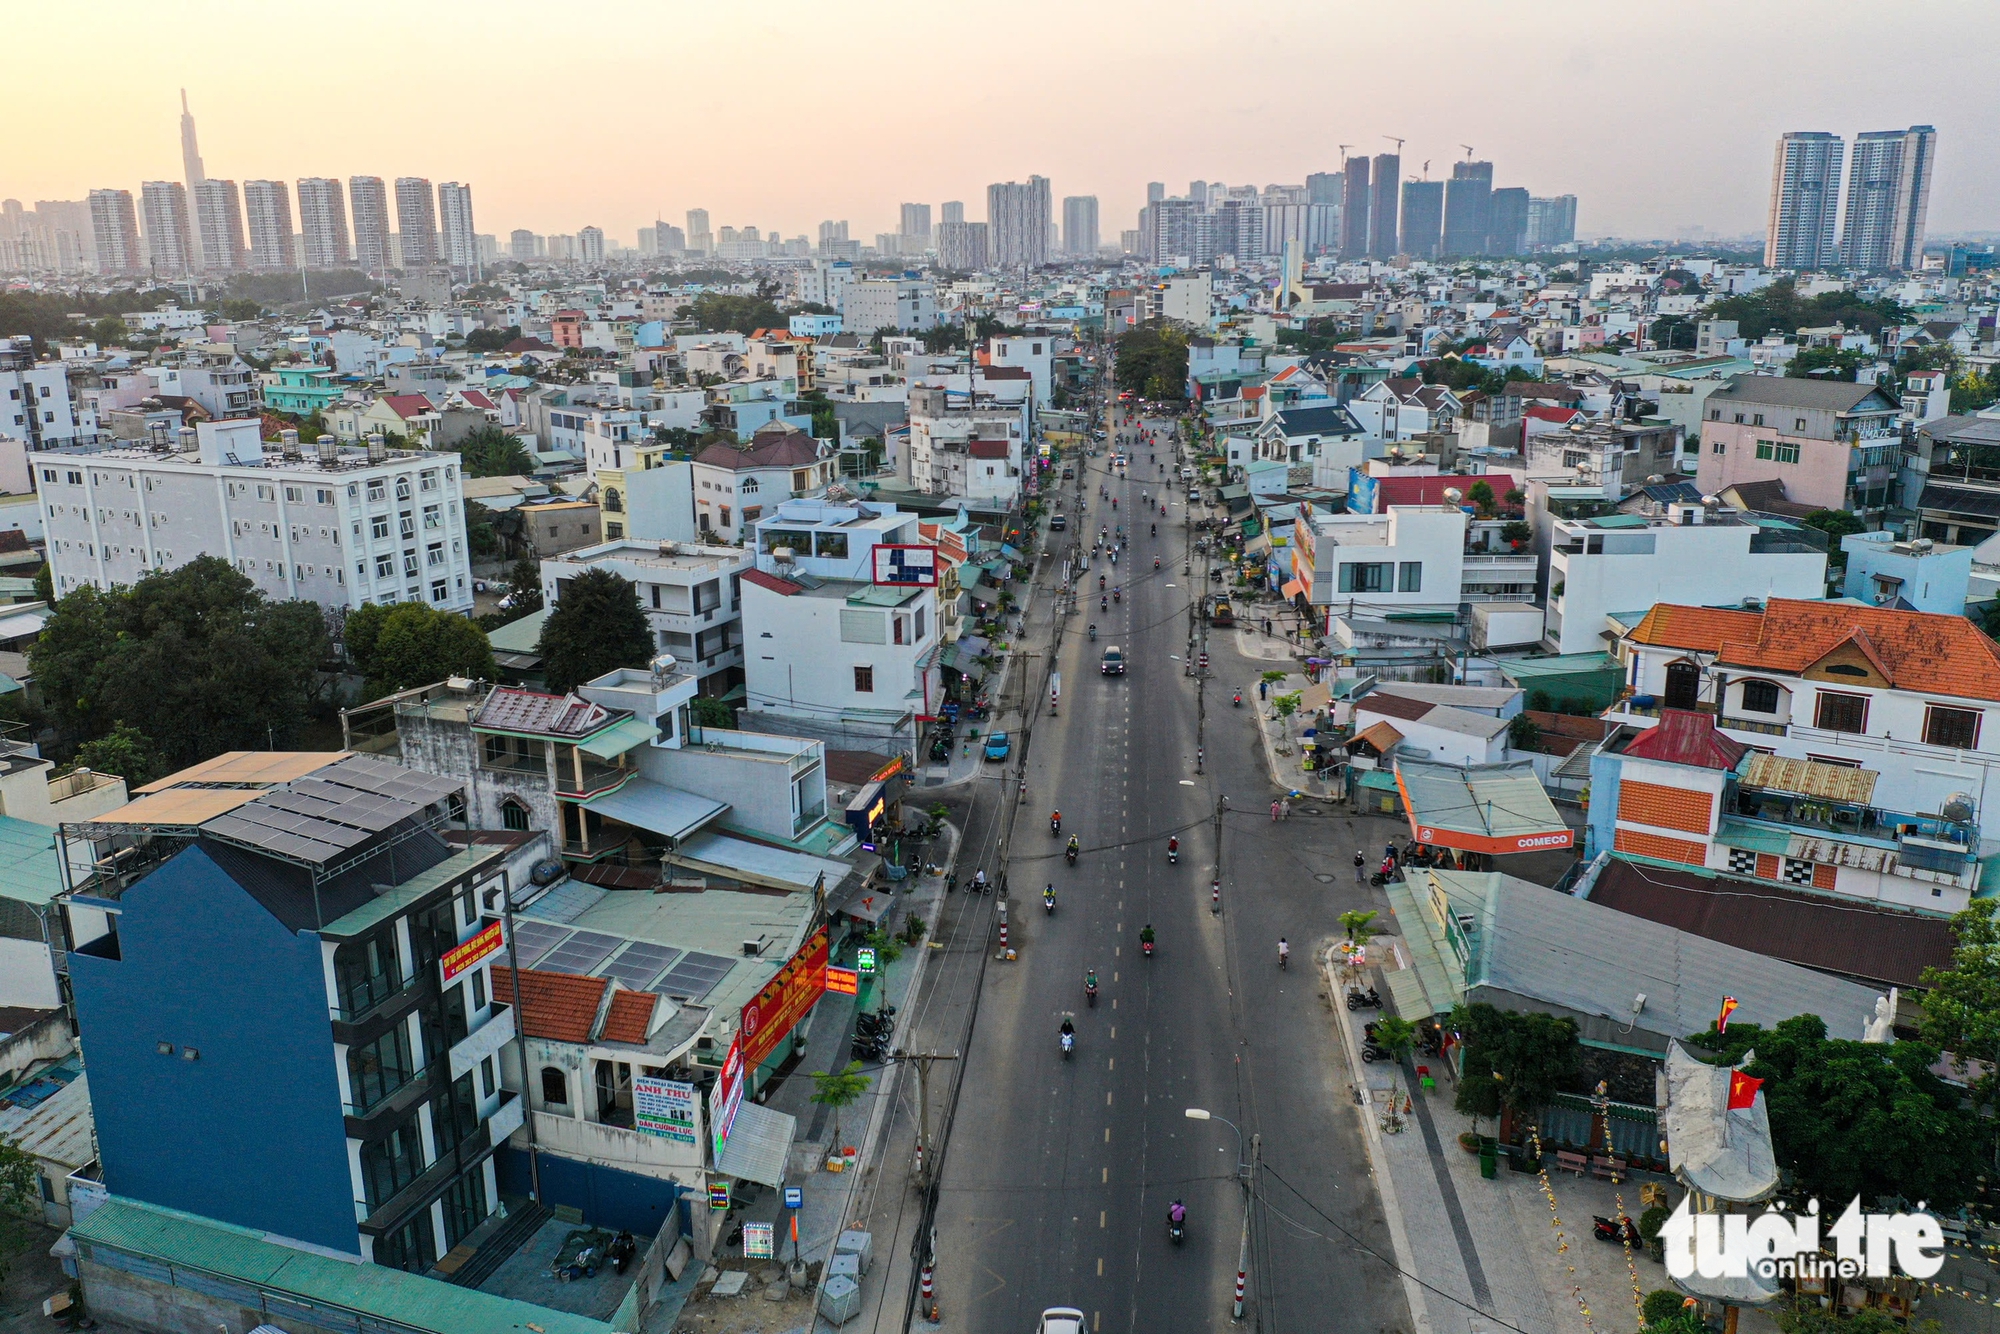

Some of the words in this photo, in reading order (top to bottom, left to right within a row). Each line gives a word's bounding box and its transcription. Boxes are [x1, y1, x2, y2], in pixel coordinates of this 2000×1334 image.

[1860, 429, 1890, 440] AMAZE
[1518, 835, 1568, 848] COMECO
[635, 1084, 662, 1094] ANH
[665, 1089, 691, 1099] THƯ
